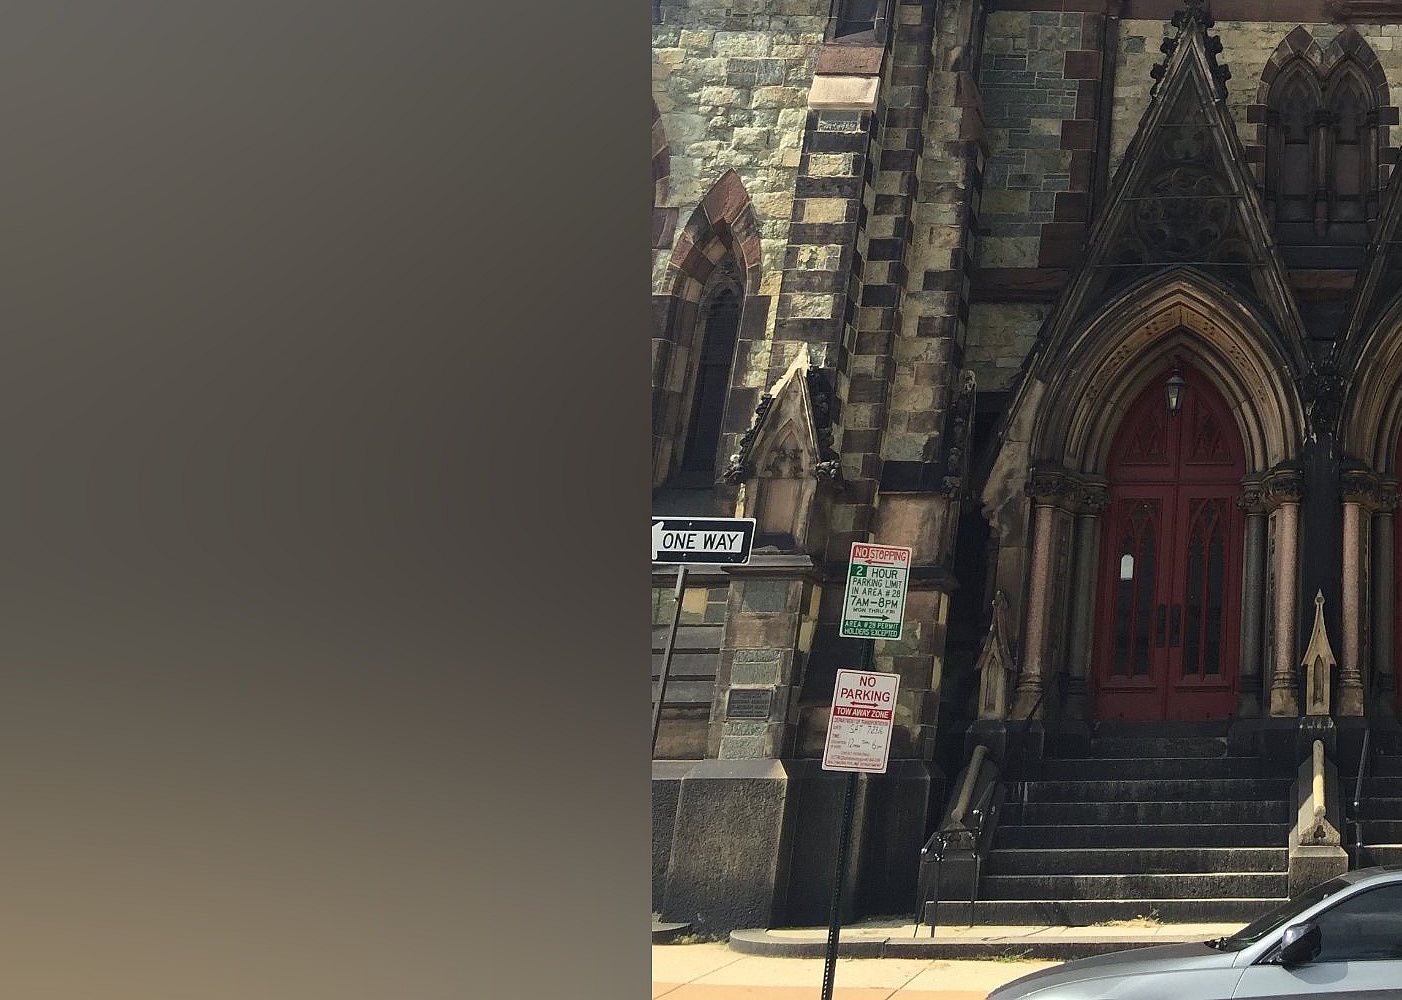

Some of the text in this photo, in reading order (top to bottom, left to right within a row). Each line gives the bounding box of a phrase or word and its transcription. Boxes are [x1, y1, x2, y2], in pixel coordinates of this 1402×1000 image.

[662, 532, 739, 550] ONE WAY
[854, 547, 906, 561] NO STOPPING
[856, 566, 863, 576] 2
[871, 568, 898, 579] HOUR
[852, 577, 902, 588] PARKING LIMIT
[851, 587, 860, 595] IN
[862, 588, 882, 596] AREA
[877, 622, 899, 630] PERMIT
[844, 628, 899, 637] HOLDERS EXCEPTED
[859, 676, 876, 687] NO
[841, 688, 890, 702] PARKING
[836, 707, 889, 719] TOW AWAY ZONE
